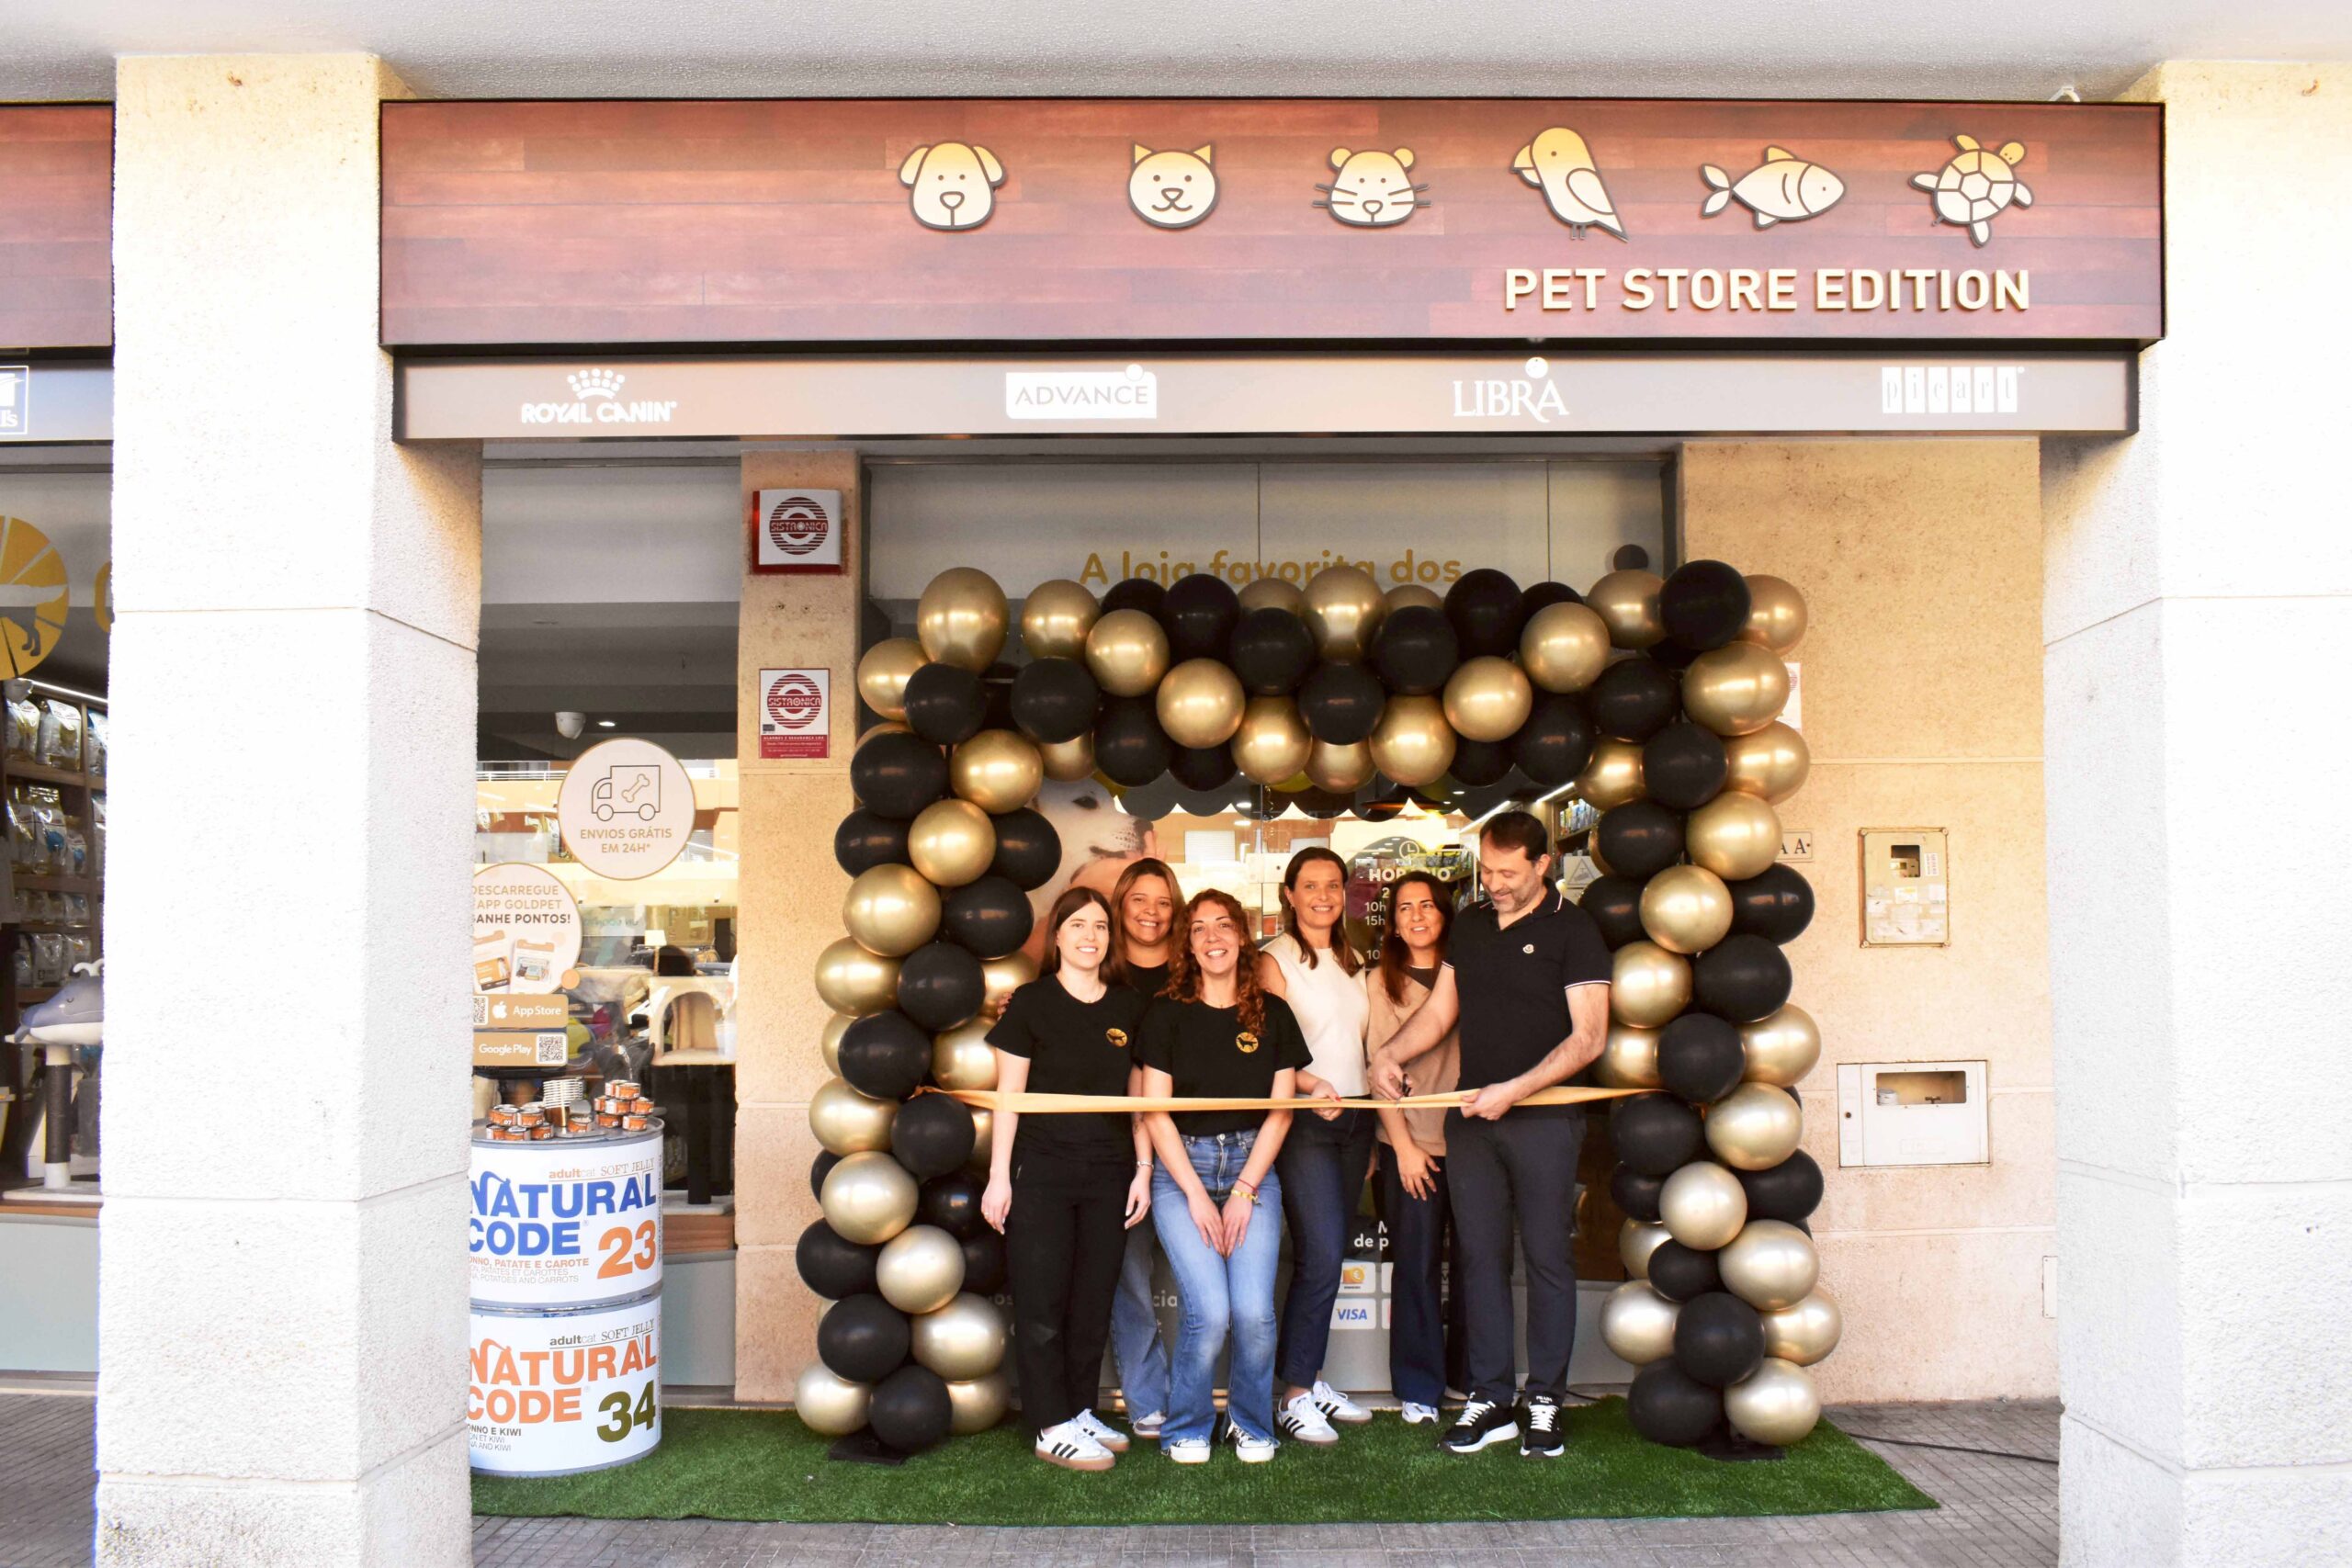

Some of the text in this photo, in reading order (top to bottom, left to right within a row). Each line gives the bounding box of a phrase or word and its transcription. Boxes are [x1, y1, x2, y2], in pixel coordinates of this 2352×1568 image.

[1505, 267, 2030, 312] PET STORE EDITION
[1015, 384, 1148, 406] ADVANCE
[1452, 378, 1570, 423] LIBRA
[1885, 372, 2012, 410] picart
[521, 402, 593, 423] ROYAL
[1079, 552, 1108, 584] A
[1390, 548, 1463, 583] dos
[580, 826, 672, 840] ENVIOS GRÁTIS
[601, 843, 619, 853] EM
[478, 899, 562, 909] APP GOLDPET
[472, 914, 571, 924] ANHE PONTOS!
[513, 1006, 561, 1018] App Store
[479, 1043, 532, 1055] Google Play
[601, 1162, 629, 1177] SOFT
[470, 1170, 656, 1219] NATURAL
[469, 1217, 581, 1256] CODE
[1353, 1233, 1374, 1247] de
[597, 1219, 656, 1279] 23
[494, 1258, 531, 1269] PATATE
[535, 1259, 542, 1269] E
[545, 1258, 589, 1269] CAROTE
[1338, 1308, 1368, 1320] VISA
[601, 1327, 629, 1342] SOFT
[632, 1318, 654, 1336] JELLY
[469, 1335, 656, 1386] NATURAL
[468, 1385, 582, 1424] CODE
[597, 1380, 656, 1442] 34
[500, 1427, 522, 1437] KIWI
